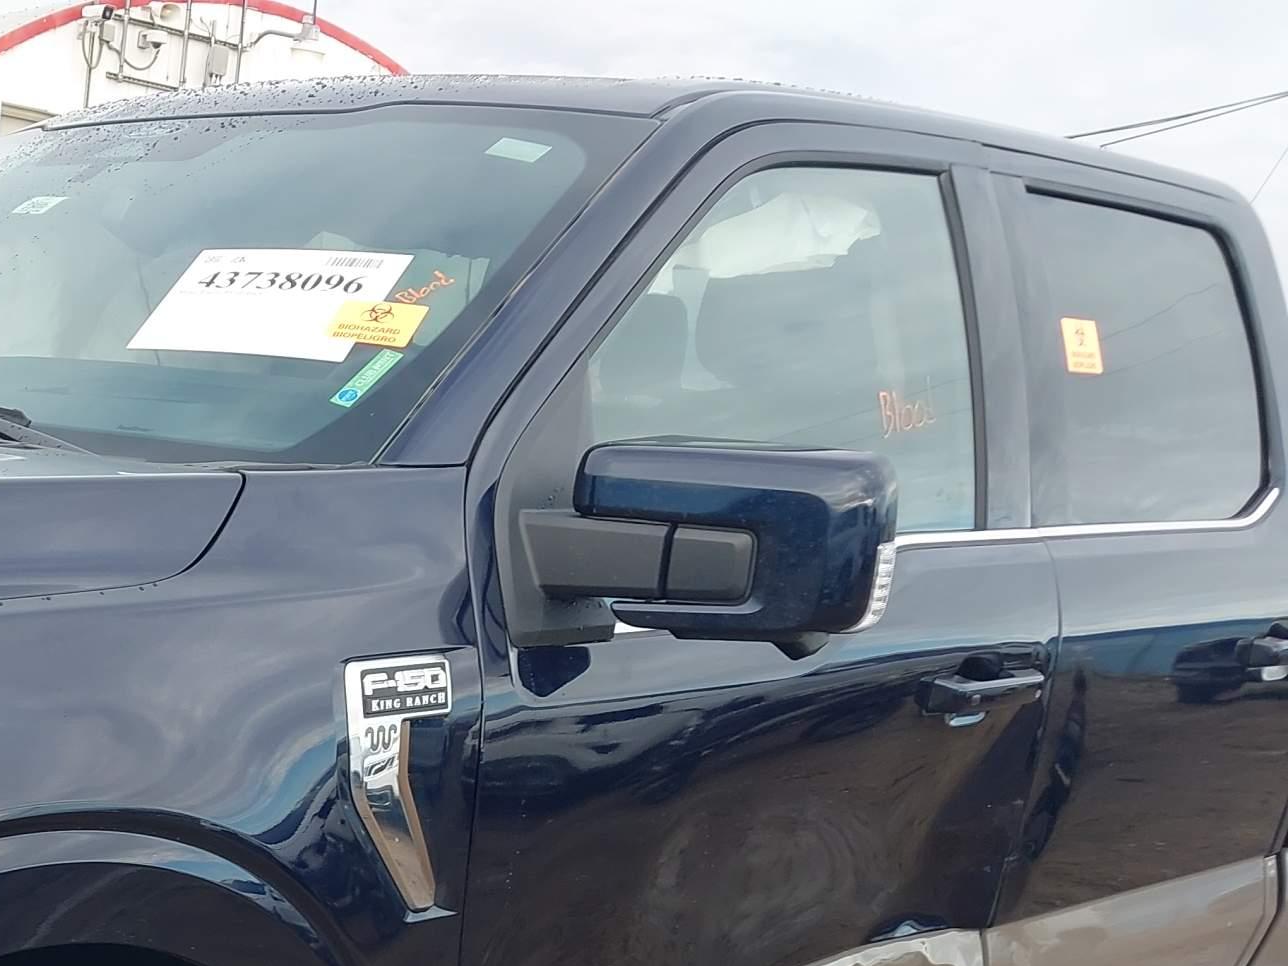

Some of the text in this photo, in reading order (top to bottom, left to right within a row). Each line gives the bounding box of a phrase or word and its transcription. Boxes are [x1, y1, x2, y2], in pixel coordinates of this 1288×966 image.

[198, 270, 368, 294] 43738096
[395, 270, 455, 304] Blood
[332, 331, 397, 343] BIOPELIGRO
[337, 323, 401, 335] BIOHAZARD
[879, 376, 936, 438] Blood
[371, 692, 446, 712] KING RANCH
